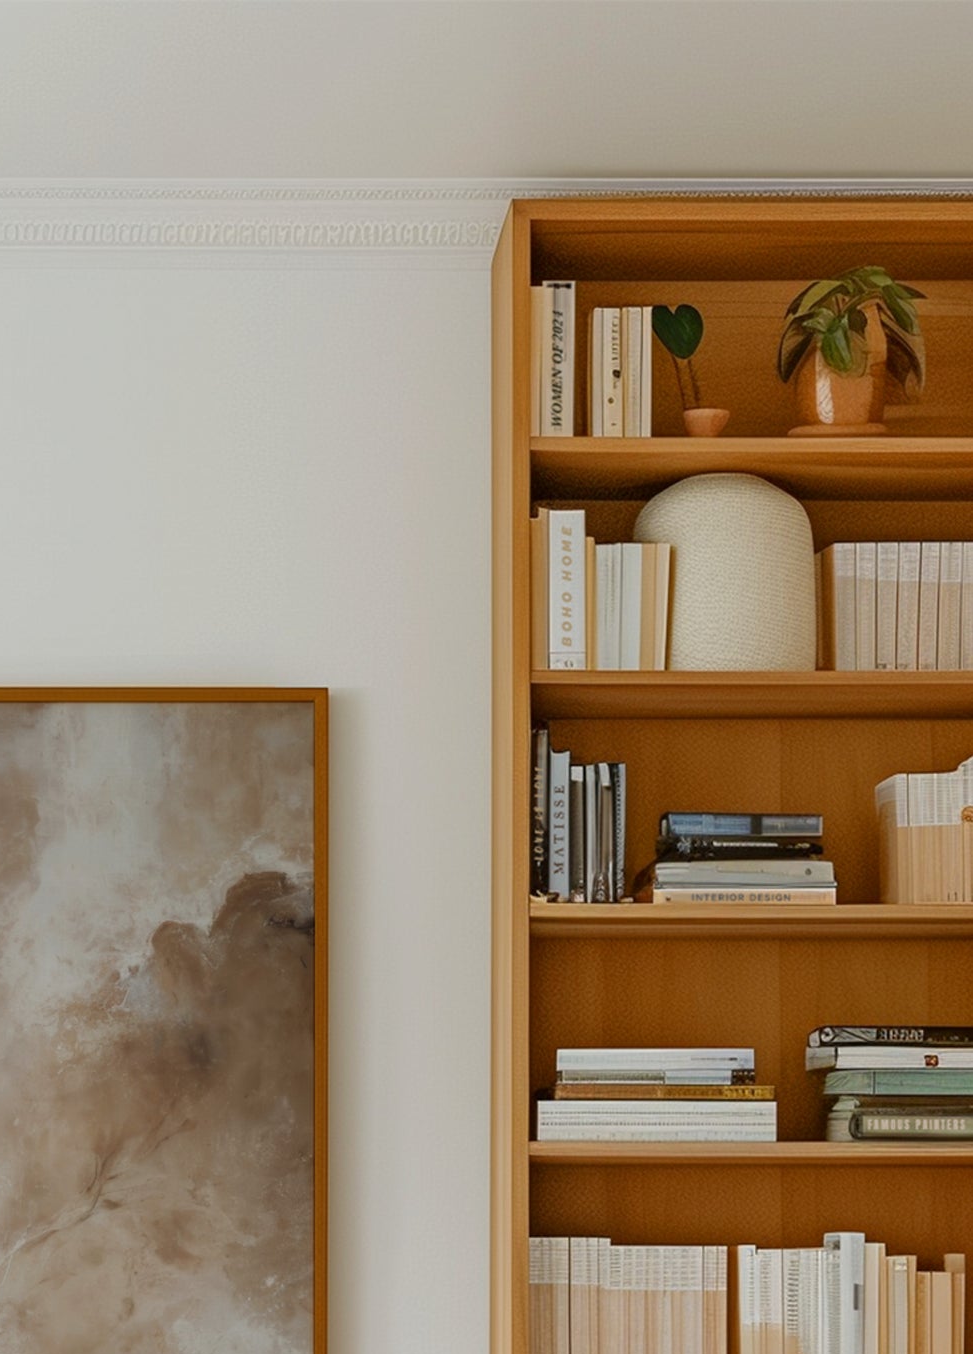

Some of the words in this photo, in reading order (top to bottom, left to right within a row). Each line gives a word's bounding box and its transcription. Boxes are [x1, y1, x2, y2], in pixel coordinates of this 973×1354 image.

[551, 344, 564, 364] OF
[551, 367, 563, 427] WOMEN
[561, 526, 573, 581] HOME
[561, 592, 573, 647] BOHO
[553, 785, 565, 874] MATISSE
[691, 893, 745, 901] INTERIOR
[750, 893, 791, 901] DESIGN
[867, 1118, 910, 1130] FAMOUS
[915, 1118, 966, 1130] PAINTERS
